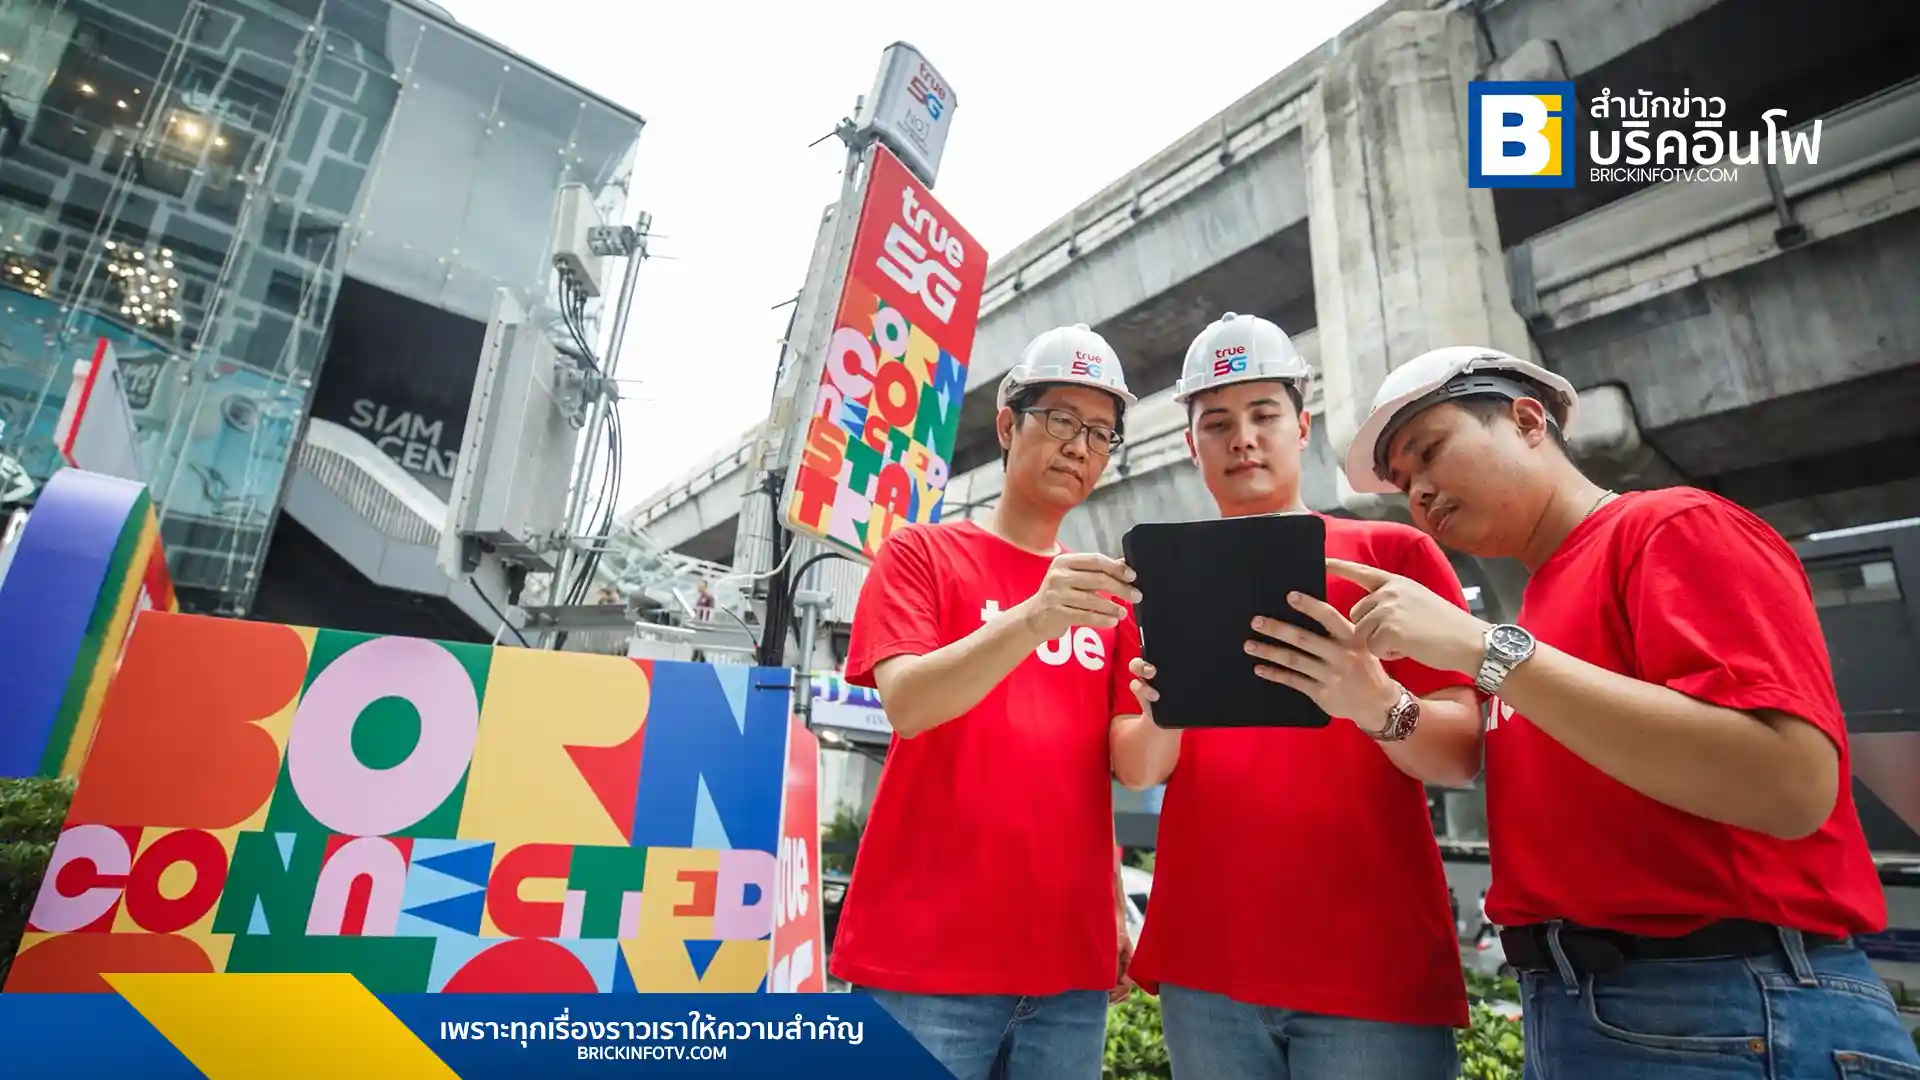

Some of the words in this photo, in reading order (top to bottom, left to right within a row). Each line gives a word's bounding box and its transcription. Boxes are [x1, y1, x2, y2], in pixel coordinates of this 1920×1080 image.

[906, 76, 944, 121] 5G
[919, 62, 946, 100] true
[902, 184, 965, 269] true
[876, 222, 963, 325] 5G
[1071, 361, 1102, 378] 5G
[1075, 350, 1102, 364] true
[1213, 355, 1248, 377] 5G
[1215, 345, 1246, 359] true
[348, 398, 443, 447] SIAM
[376, 435, 459, 479] CENT
[65, 611, 792, 848] BORN
[28, 824, 778, 941] CONNECTED
